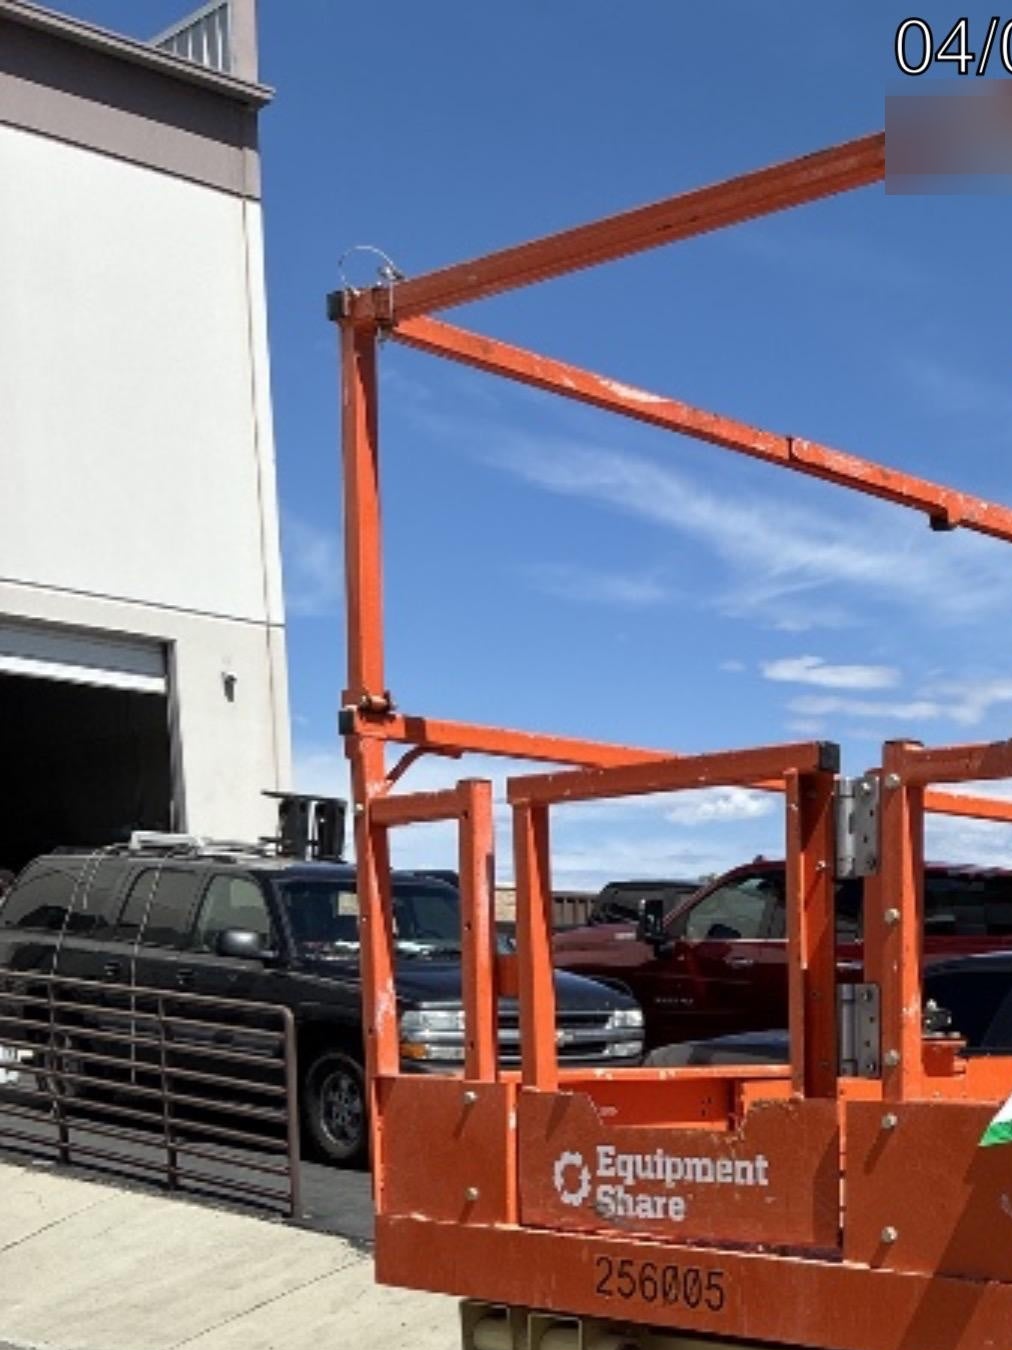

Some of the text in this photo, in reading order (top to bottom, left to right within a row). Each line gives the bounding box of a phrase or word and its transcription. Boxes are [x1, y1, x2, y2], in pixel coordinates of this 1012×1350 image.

[596, 1145, 769, 1188] Equipment
[596, 1184, 686, 1221] Share
[595, 1256, 726, 1312] 256005
